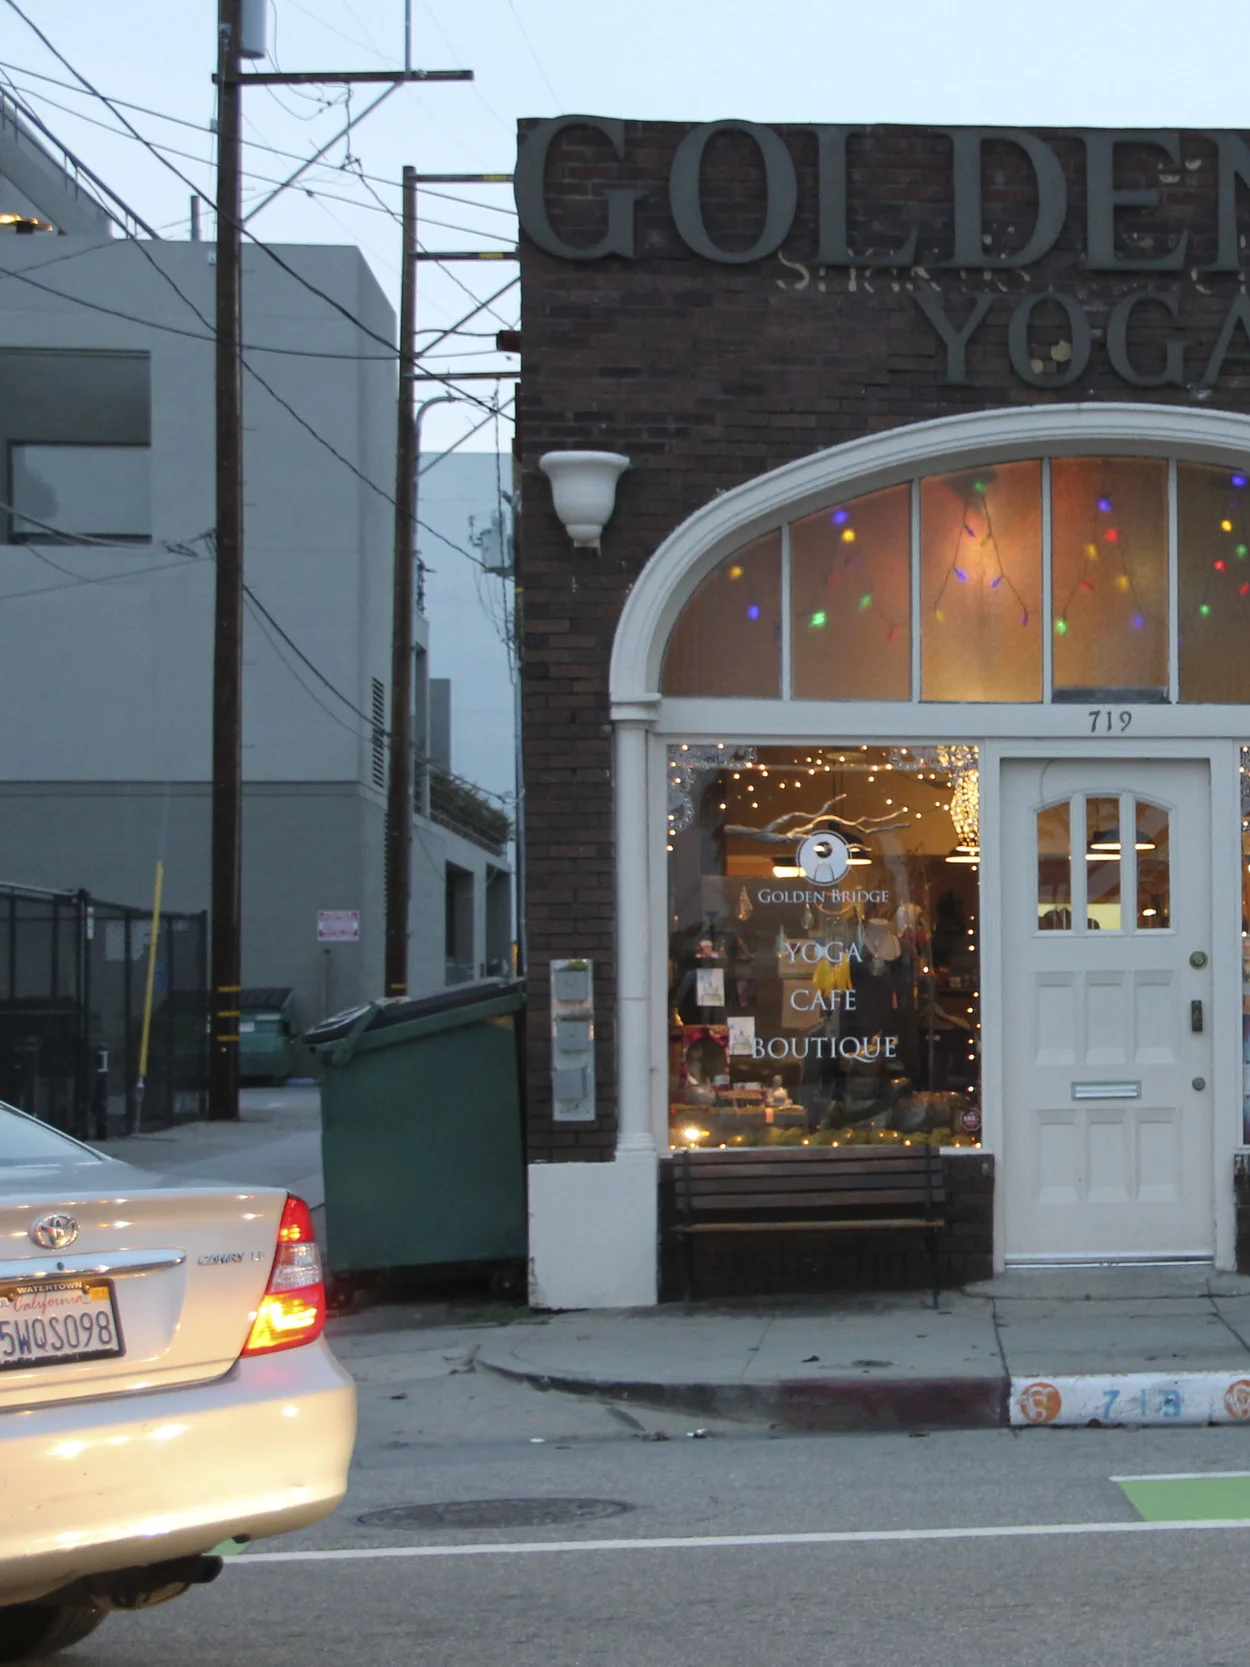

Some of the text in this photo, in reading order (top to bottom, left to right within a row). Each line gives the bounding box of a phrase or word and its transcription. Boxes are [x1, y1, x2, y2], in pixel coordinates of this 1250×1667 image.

[1088, 710, 1132, 733] 719
[757, 888, 889, 904] GOLDEN BRIDGE
[783, 941, 864, 964] YOGA
[790, 990, 857, 1011] CAFE
[752, 1036, 897, 1064] BOUTIQUE
[17, 1281, 83, 1295] WATERTOWN
[13, 1294, 92, 1314] California
[0, 1311, 113, 1356] 5WQS098
